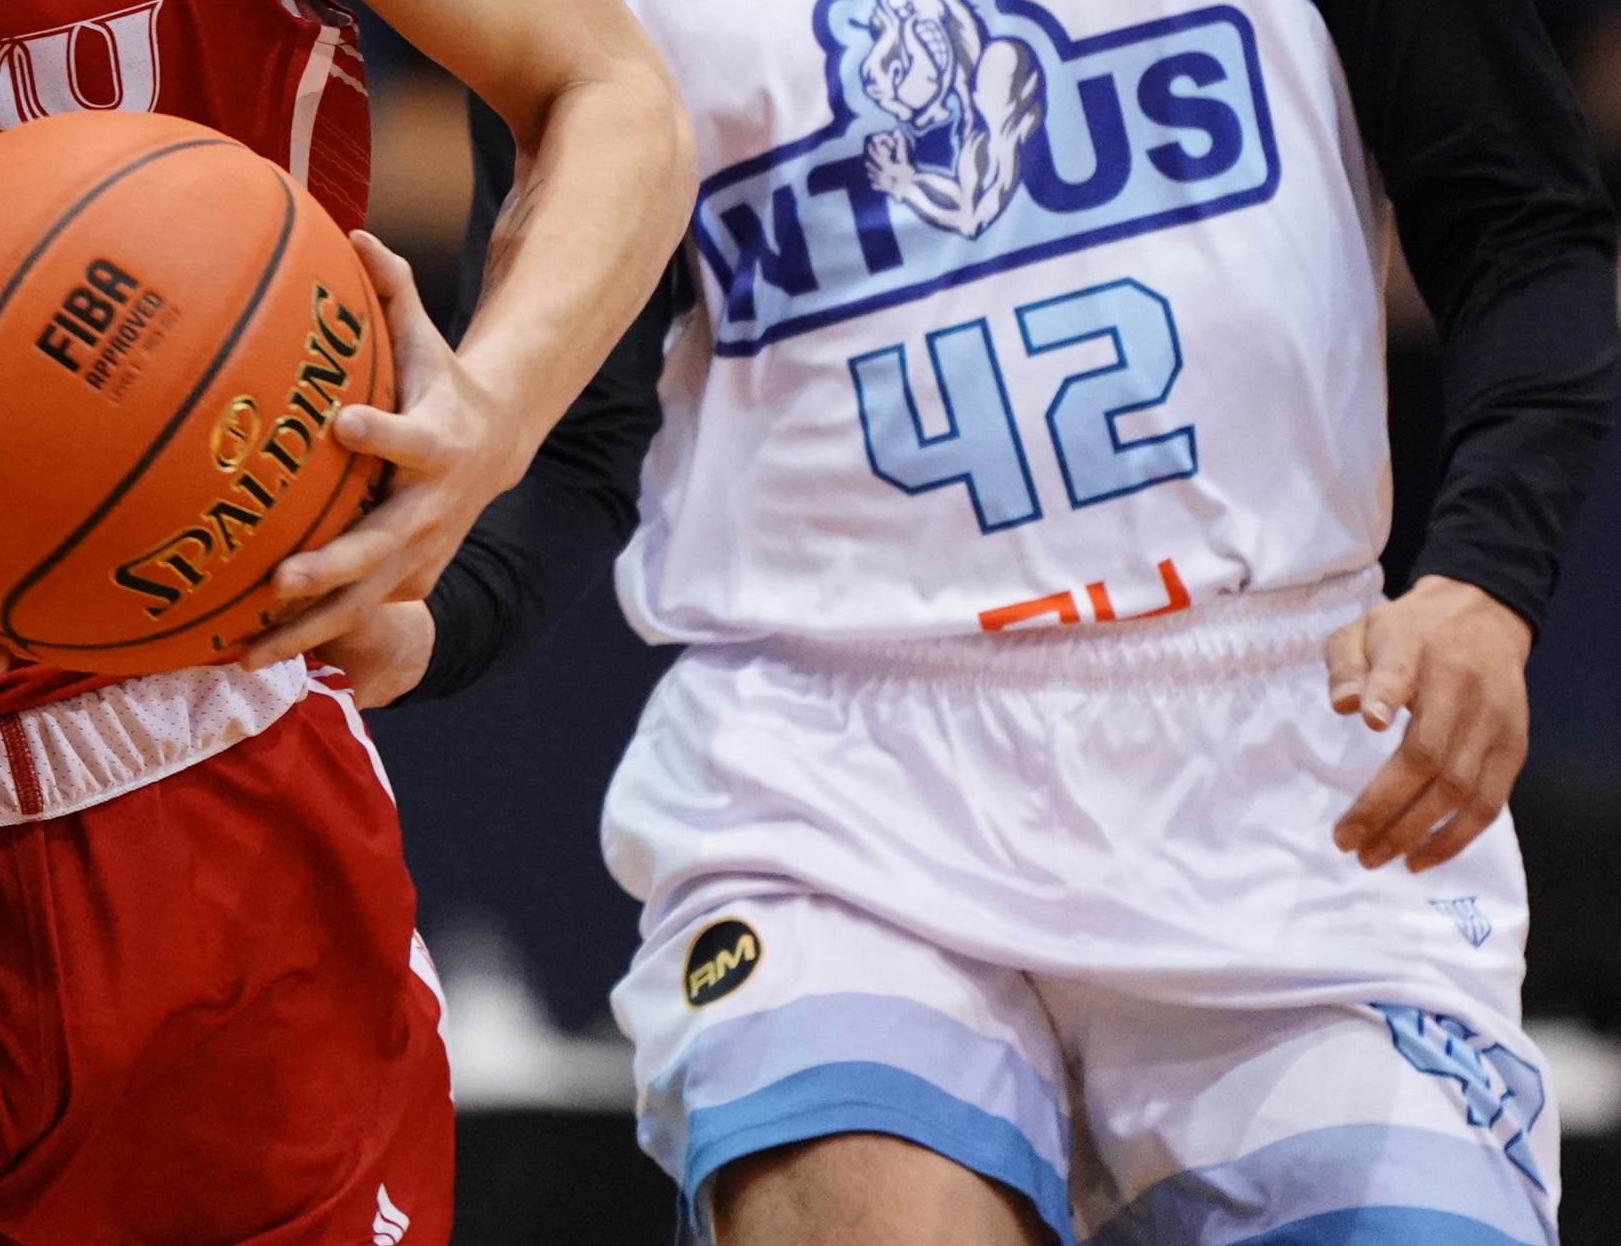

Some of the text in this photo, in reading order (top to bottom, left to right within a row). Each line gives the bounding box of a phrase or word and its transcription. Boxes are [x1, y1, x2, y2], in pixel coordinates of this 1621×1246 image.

[35, 258, 139, 374] FIBA
[85, 290, 164, 391] APPROVED
[848, 276, 1200, 535] 42
[107, 281, 368, 622] SPALDING
